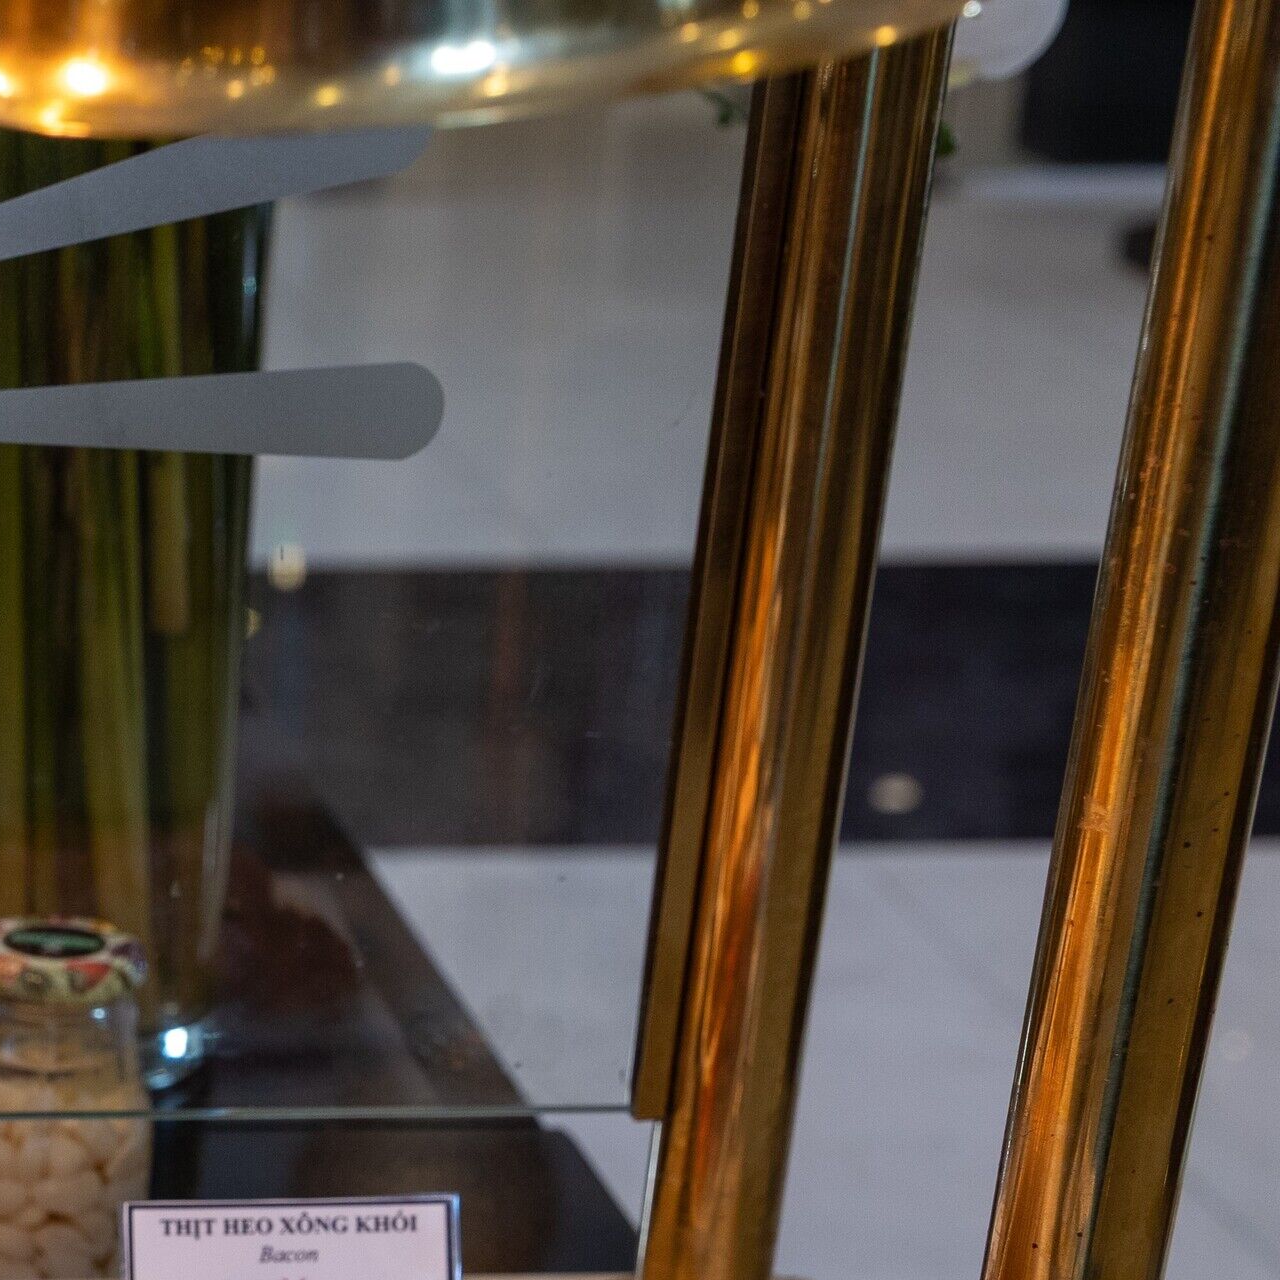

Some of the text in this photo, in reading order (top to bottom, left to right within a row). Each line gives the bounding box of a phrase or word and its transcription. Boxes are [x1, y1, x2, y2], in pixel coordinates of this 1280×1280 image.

[159, 1210, 418, 1240] THỊT HEO XÔNG KHÓI
[259, 1247, 318, 1264] Bacon
